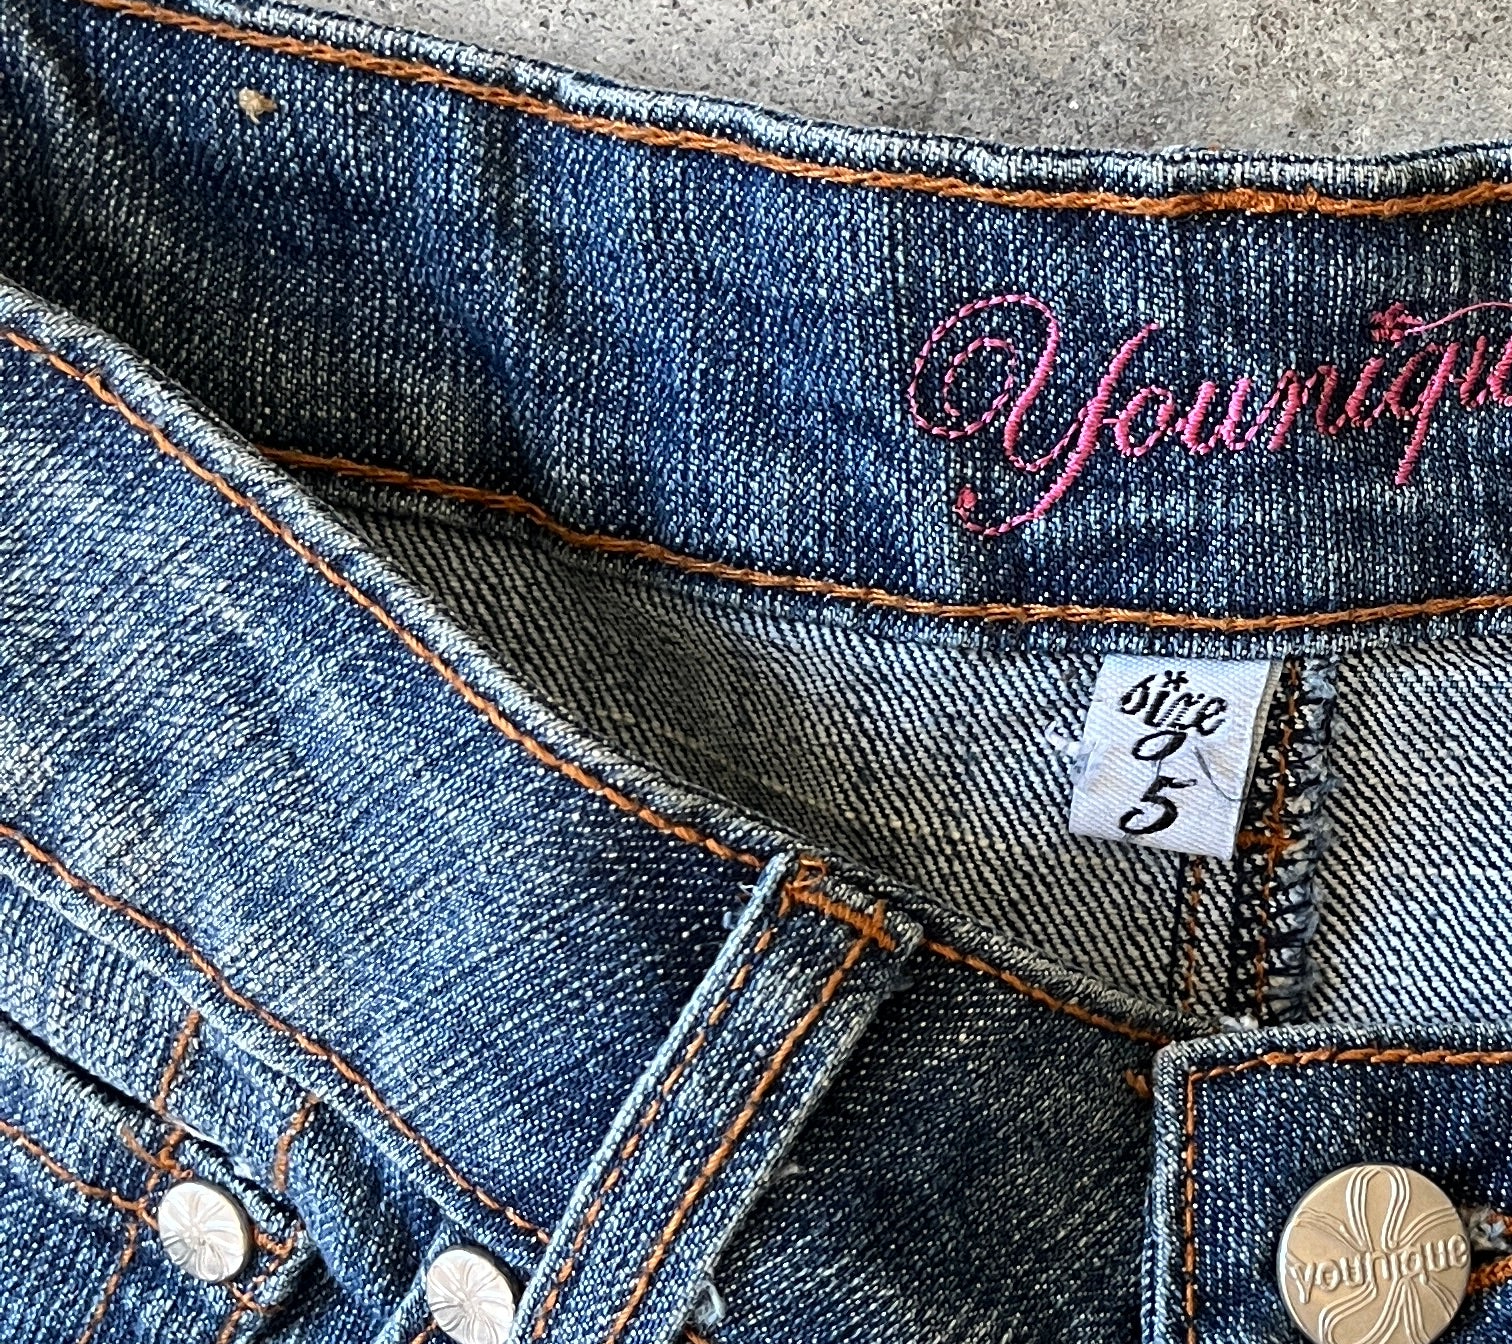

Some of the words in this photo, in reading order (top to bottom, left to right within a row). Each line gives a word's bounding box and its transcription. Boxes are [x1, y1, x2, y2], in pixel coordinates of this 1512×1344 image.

[1119, 669, 1228, 761] size
[1119, 775, 1197, 834] 5
[1290, 1233, 1468, 1305] younique
